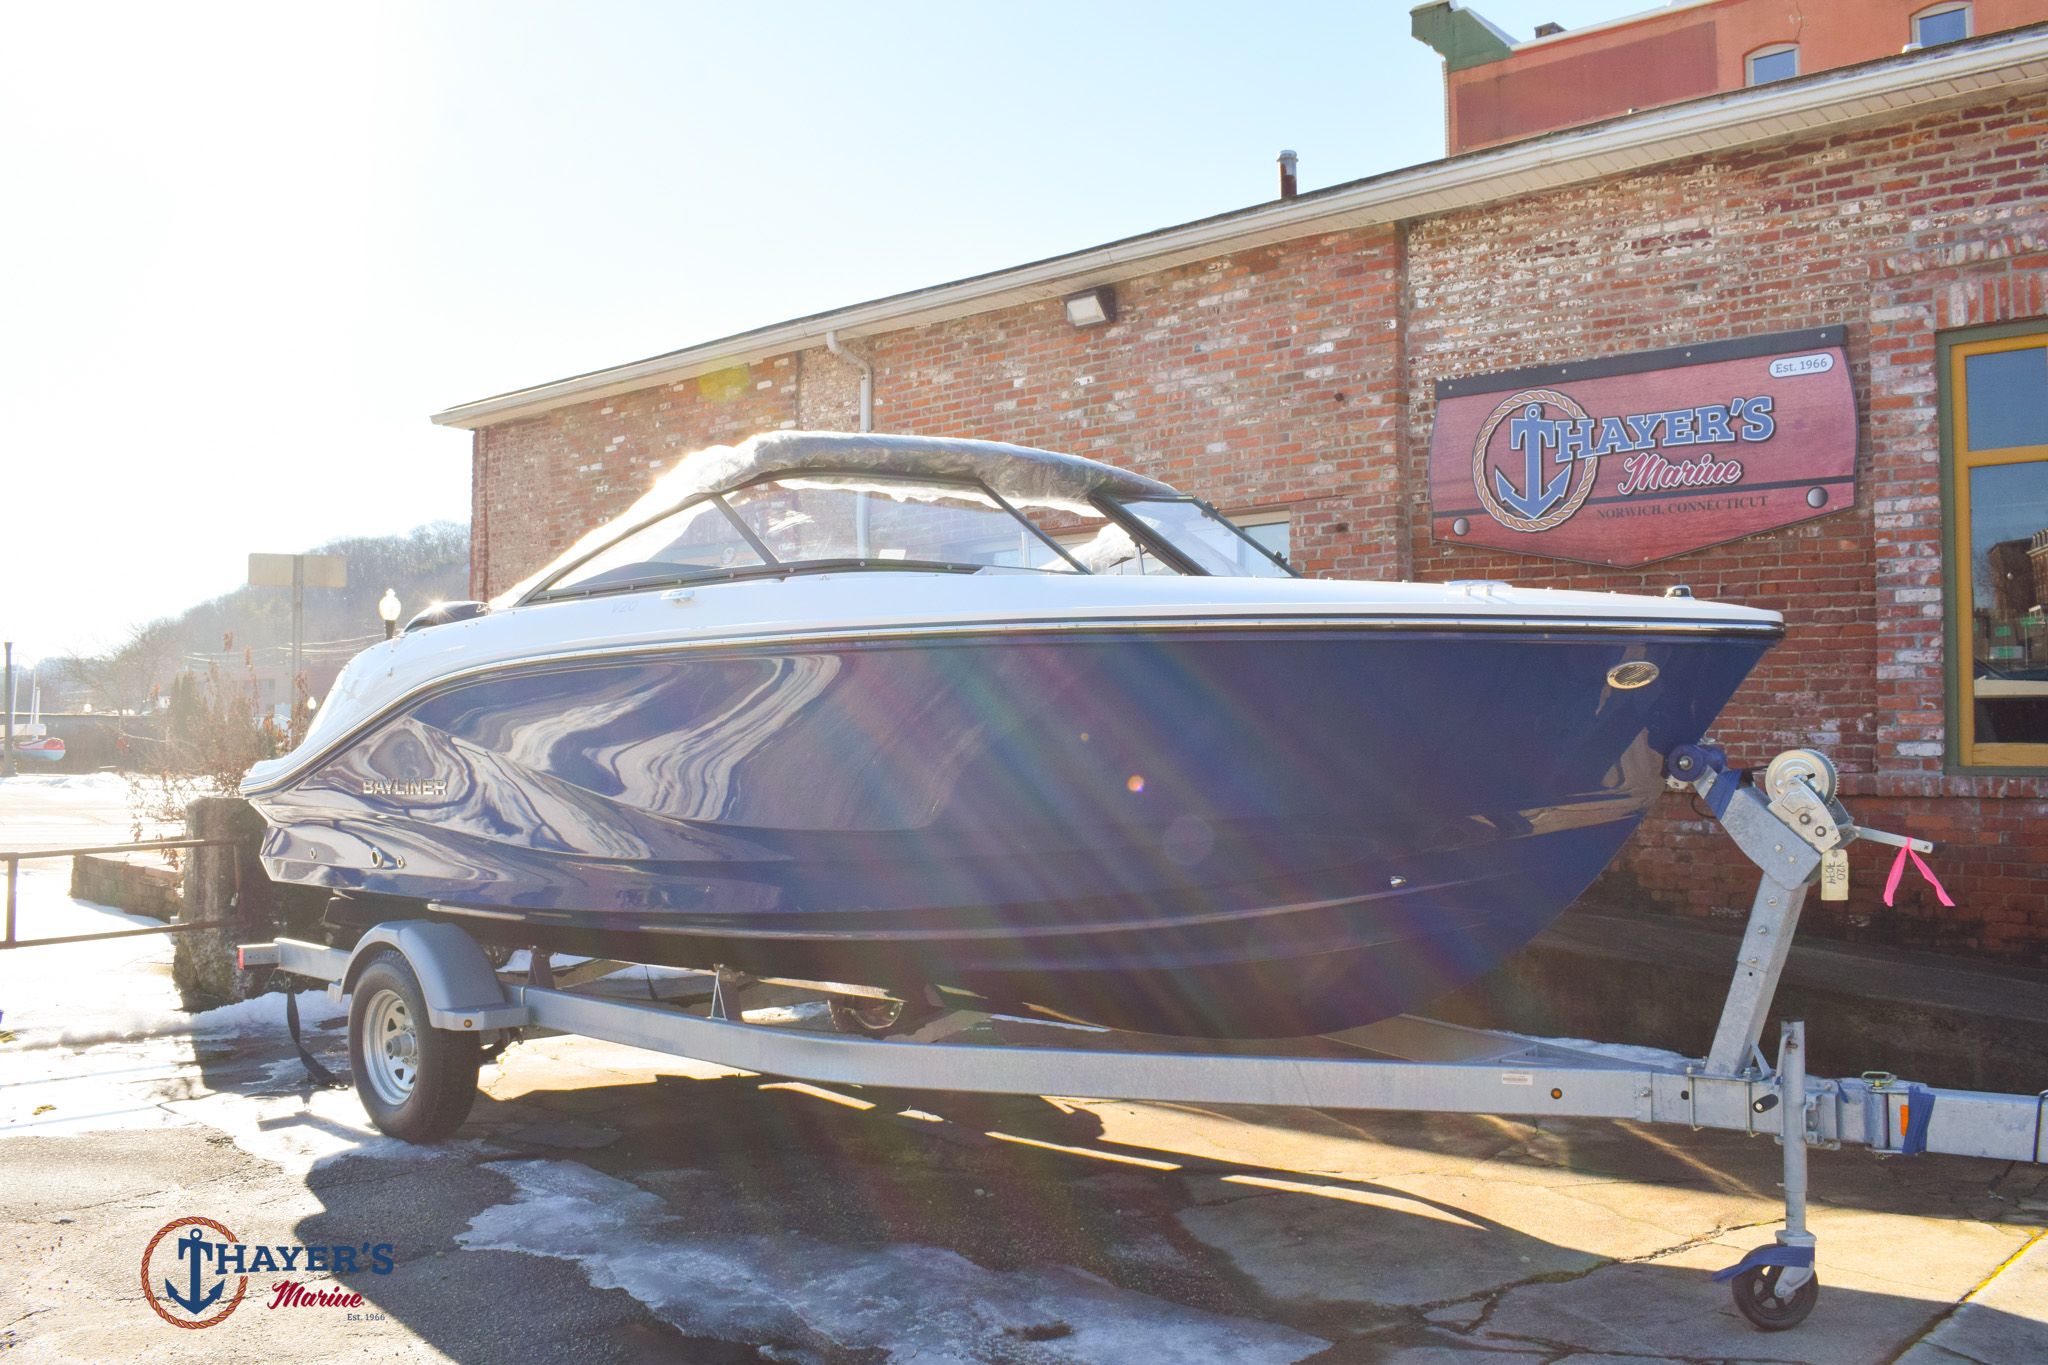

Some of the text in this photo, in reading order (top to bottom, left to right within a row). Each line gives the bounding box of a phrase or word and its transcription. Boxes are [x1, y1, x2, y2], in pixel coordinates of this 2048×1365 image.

[1775, 358, 1828, 373] Est. 1966
[1618, 452, 1744, 496] Marine
[1667, 495, 1768, 514] CONNECTICUT
[363, 779, 447, 795] BAYLINER
